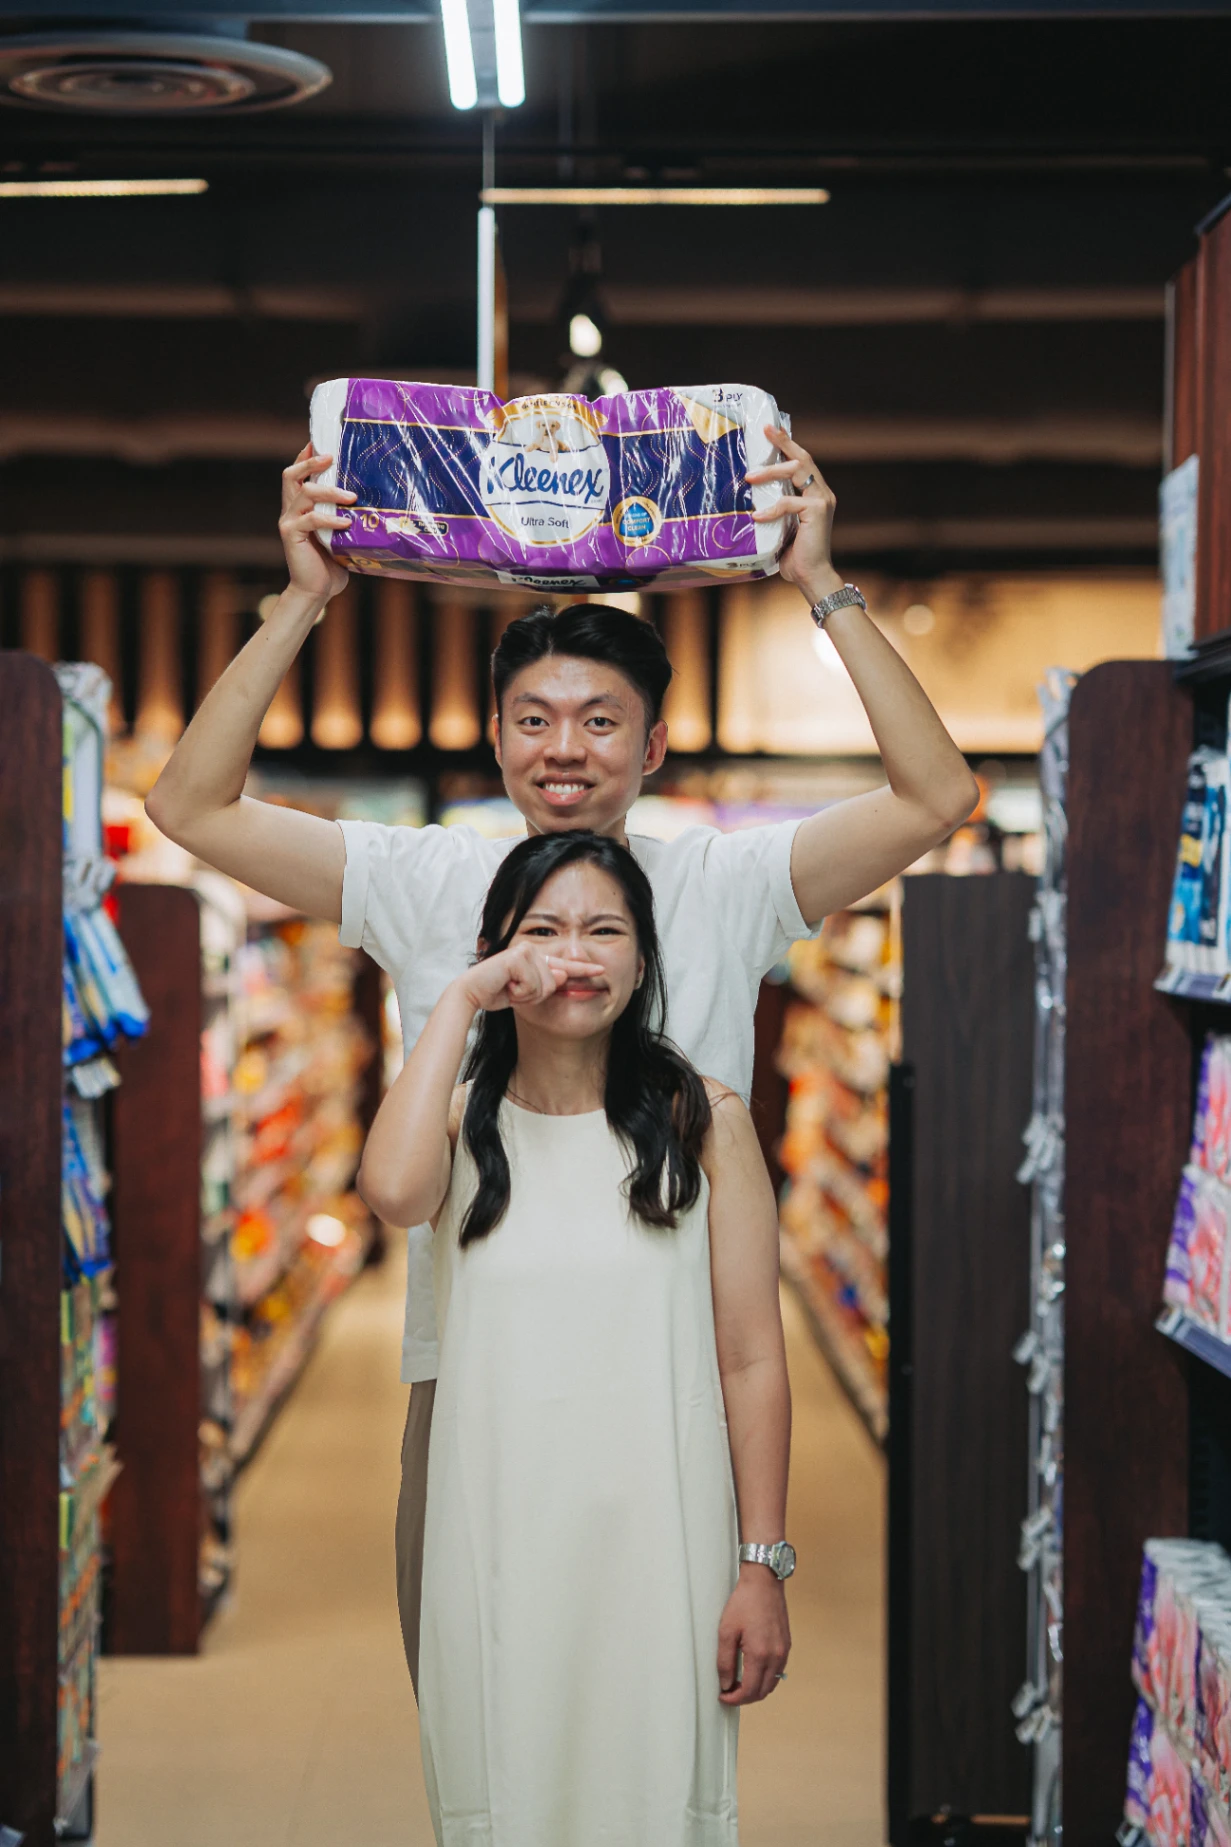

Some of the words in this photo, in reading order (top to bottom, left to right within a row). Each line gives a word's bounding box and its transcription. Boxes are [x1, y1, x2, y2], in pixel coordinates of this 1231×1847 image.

[712, 387, 724, 402] 3
[726, 392, 743, 402] PLY
[487, 453, 605, 505] Kleenex
[359, 513, 379, 529] 10
[521, 516, 545, 527] Ultra
[547, 517, 570, 529] Soft
